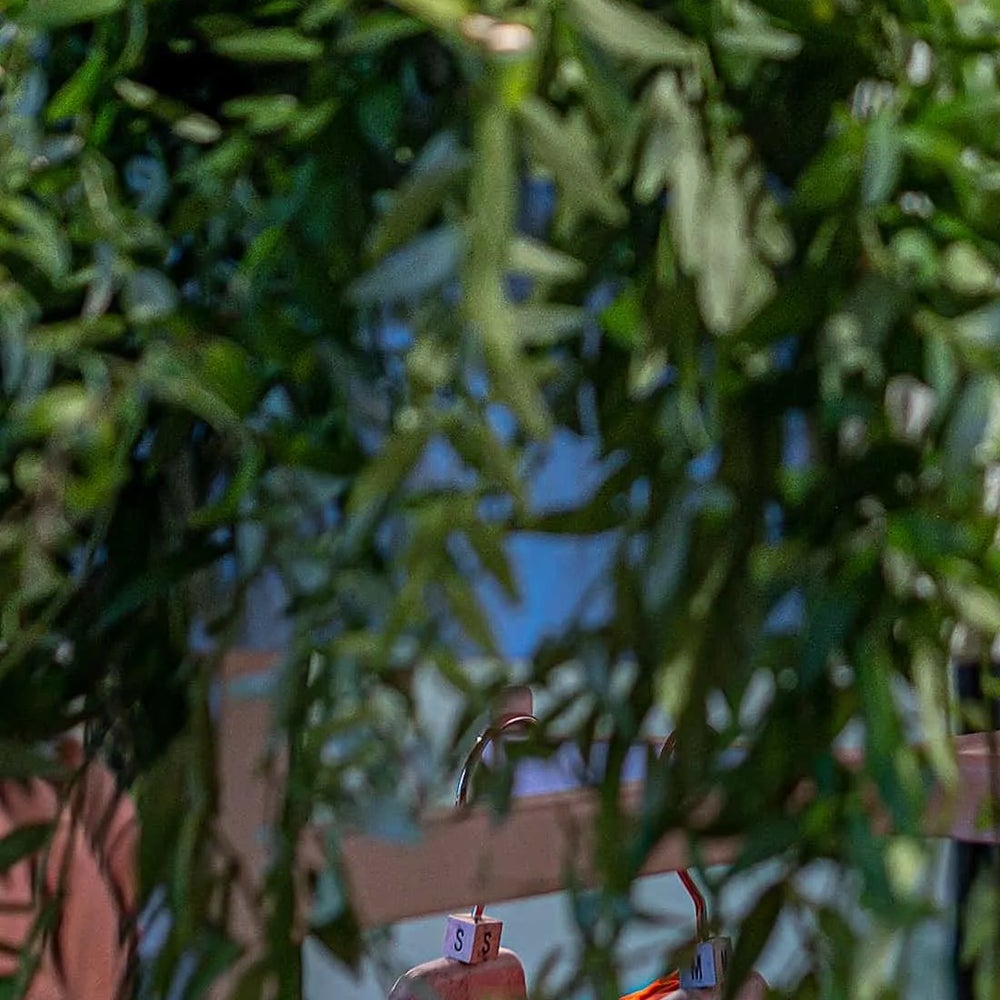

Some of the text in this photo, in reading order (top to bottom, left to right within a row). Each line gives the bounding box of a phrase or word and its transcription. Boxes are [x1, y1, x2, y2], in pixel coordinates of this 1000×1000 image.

[454, 927, 465, 952] S
[482, 931, 492, 955] S
[690, 954, 703, 980] M
